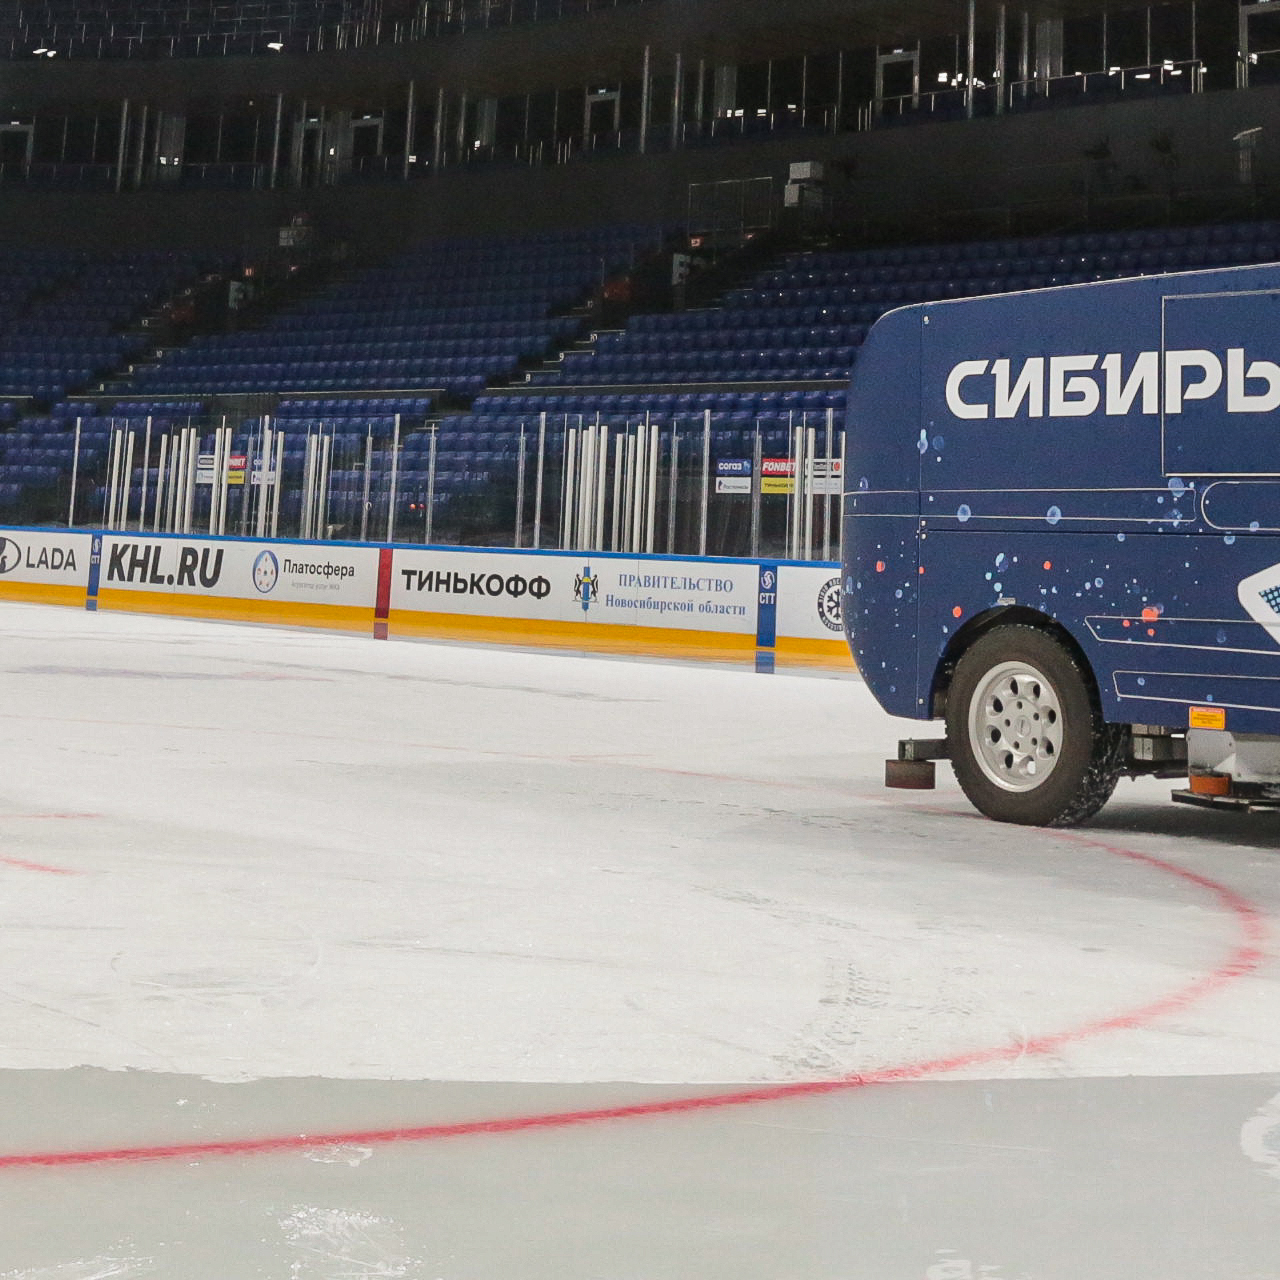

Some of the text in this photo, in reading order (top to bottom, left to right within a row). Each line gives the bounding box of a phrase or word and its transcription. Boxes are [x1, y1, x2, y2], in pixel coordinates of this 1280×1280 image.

[25, 546, 77, 571] LADA
[107, 543, 225, 589] KHL.RU
[283, 559, 355, 580] Платосфера
[401, 569, 551, 600] ТИНЬКОФФ
[619, 573, 734, 593] ПРАВИТЕЛЬСТВО
[605, 594, 746, 616] Новосибирской области
